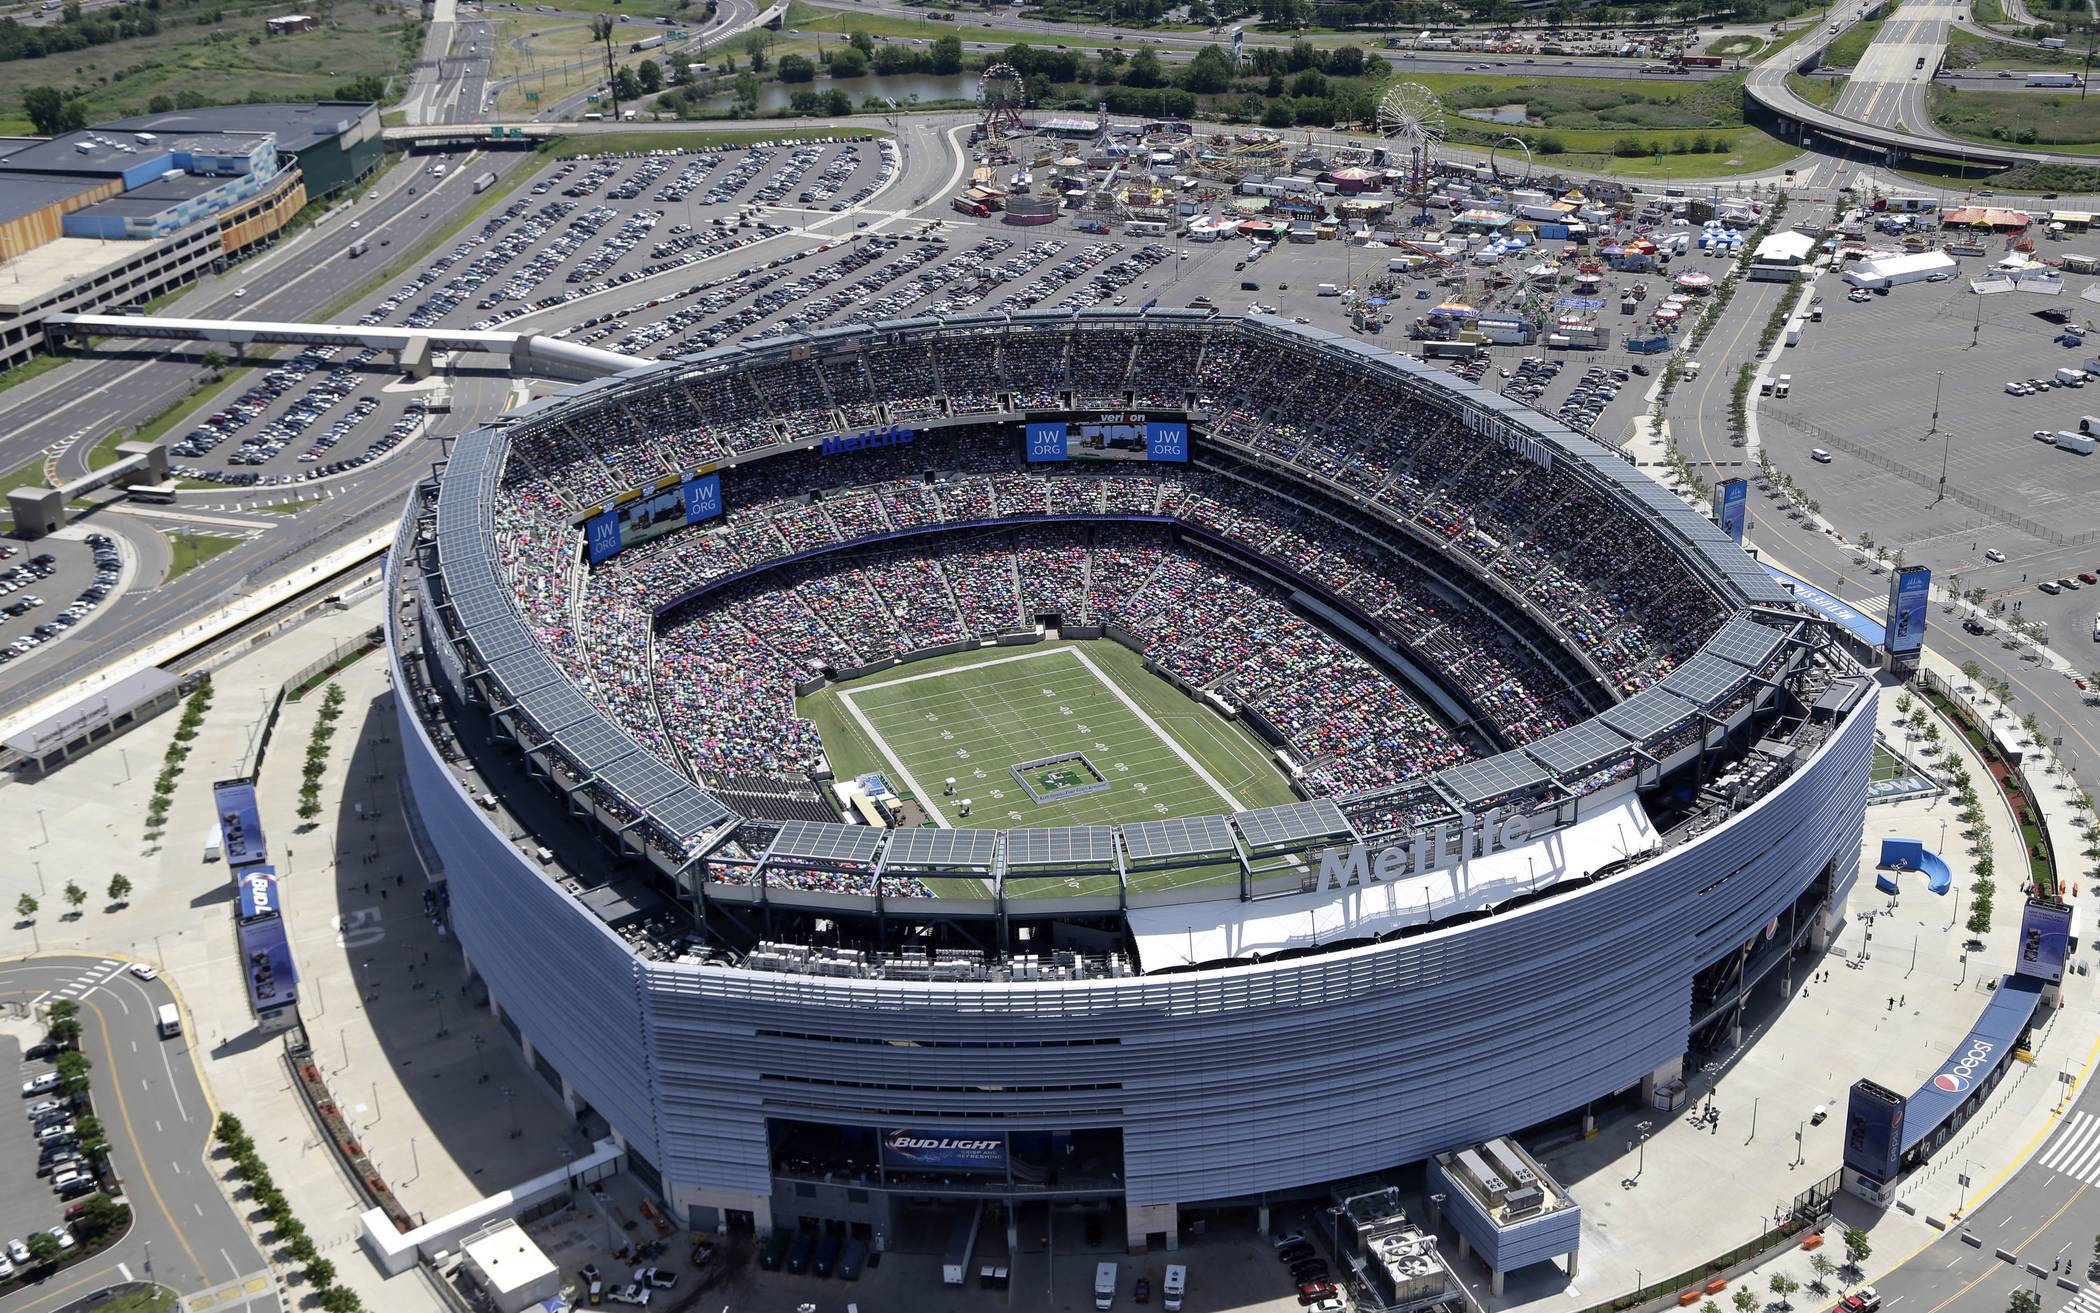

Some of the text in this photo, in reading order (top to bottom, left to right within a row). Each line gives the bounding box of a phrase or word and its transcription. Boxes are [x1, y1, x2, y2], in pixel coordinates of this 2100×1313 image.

[821, 424, 914, 456] MetLife
[1034, 430, 1060, 444] JW
[1154, 430, 1180, 444] JW
[1463, 406, 1552, 473] METLIFE STADIUM
[1032, 445, 1061, 455] .ORG
[1152, 445, 1181, 455] .ORG
[691, 484, 714, 503] JW
[690, 500, 716, 516] .ORG
[594, 520, 614, 542] JW
[1316, 807, 1532, 893] MetLife
[251, 878, 269, 906] BUD
[331, 905, 386, 948] 50
[1953, 1039, 1994, 1079] pepsi
[894, 1137, 1001, 1150] BUD LIGHT
